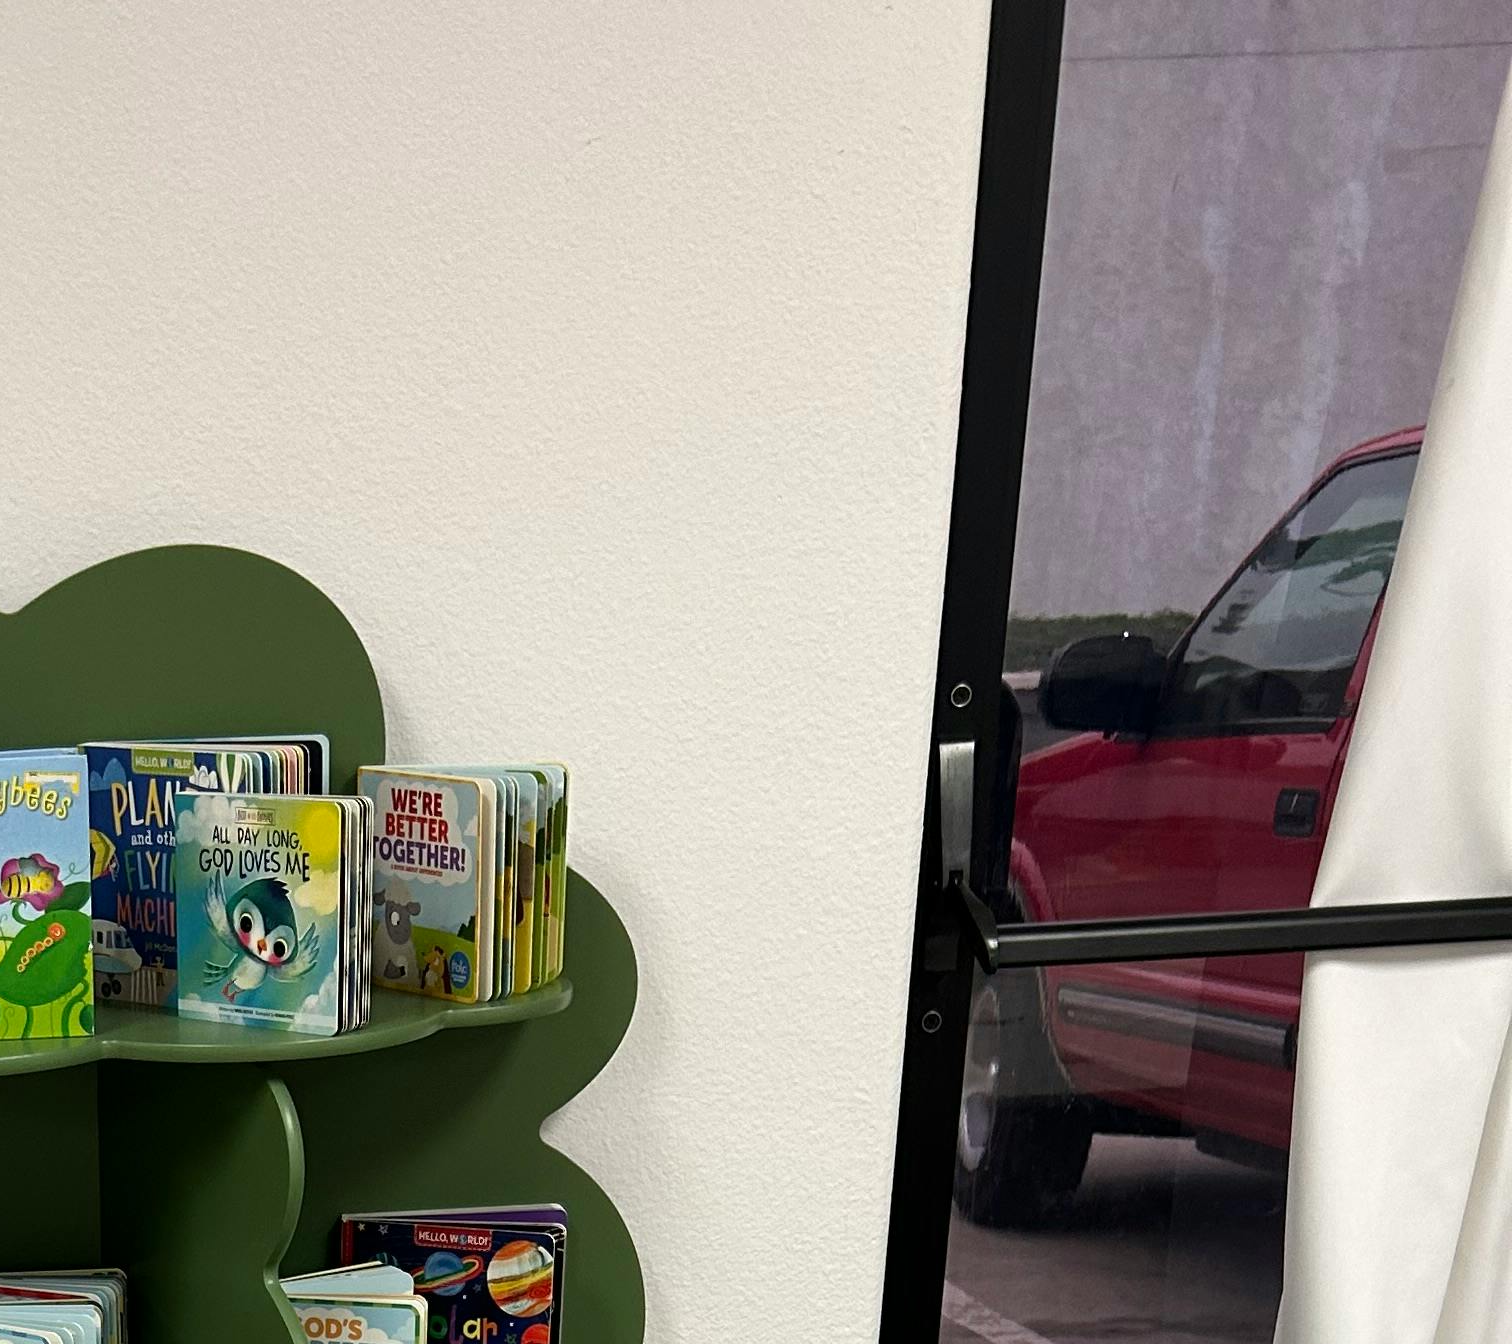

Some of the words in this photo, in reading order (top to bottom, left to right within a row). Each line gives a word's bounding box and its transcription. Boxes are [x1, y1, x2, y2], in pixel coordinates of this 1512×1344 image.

[391, 788, 442, 817] WE'RE
[131, 830, 153, 846] and
[213, 825, 230, 844] ALL
[238, 827, 259, 846] DAY
[267, 829, 302, 851] LONG,
[385, 812, 449, 844] BETTER
[199, 848, 233, 876] GOD
[239, 849, 281, 879] LOVES
[285, 851, 310, 882] ME
[373, 835, 465, 872] TOGETHER!
[418, 1231, 448, 1243] HELLO,
[301, 1317, 362, 1340] OD'S
